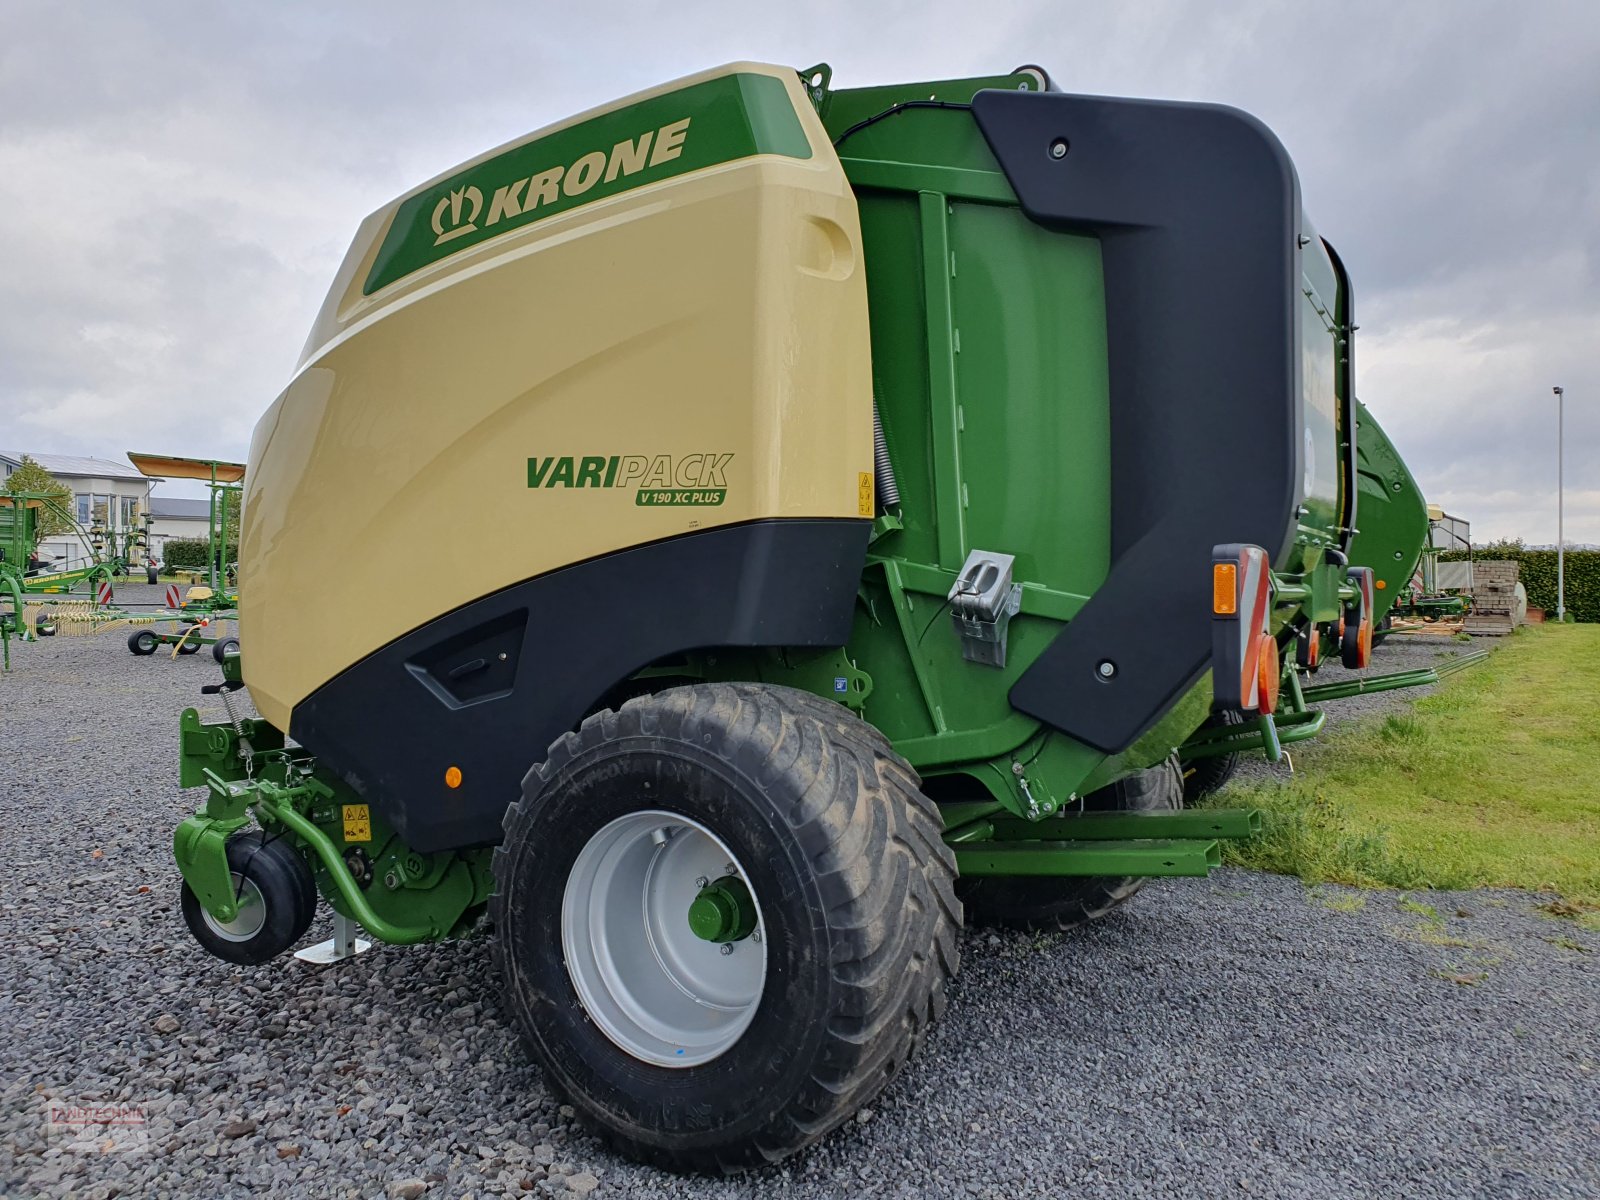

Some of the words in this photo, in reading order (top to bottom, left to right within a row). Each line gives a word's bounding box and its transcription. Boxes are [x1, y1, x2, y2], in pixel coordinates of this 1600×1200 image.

[485, 117, 691, 227] KRONE
[527, 453, 735, 488] VARIPACK
[641, 492, 650, 503] V
[652, 492, 672, 503] 190
[674, 492, 690, 503] XC
[691, 492, 720, 503] PLUS
